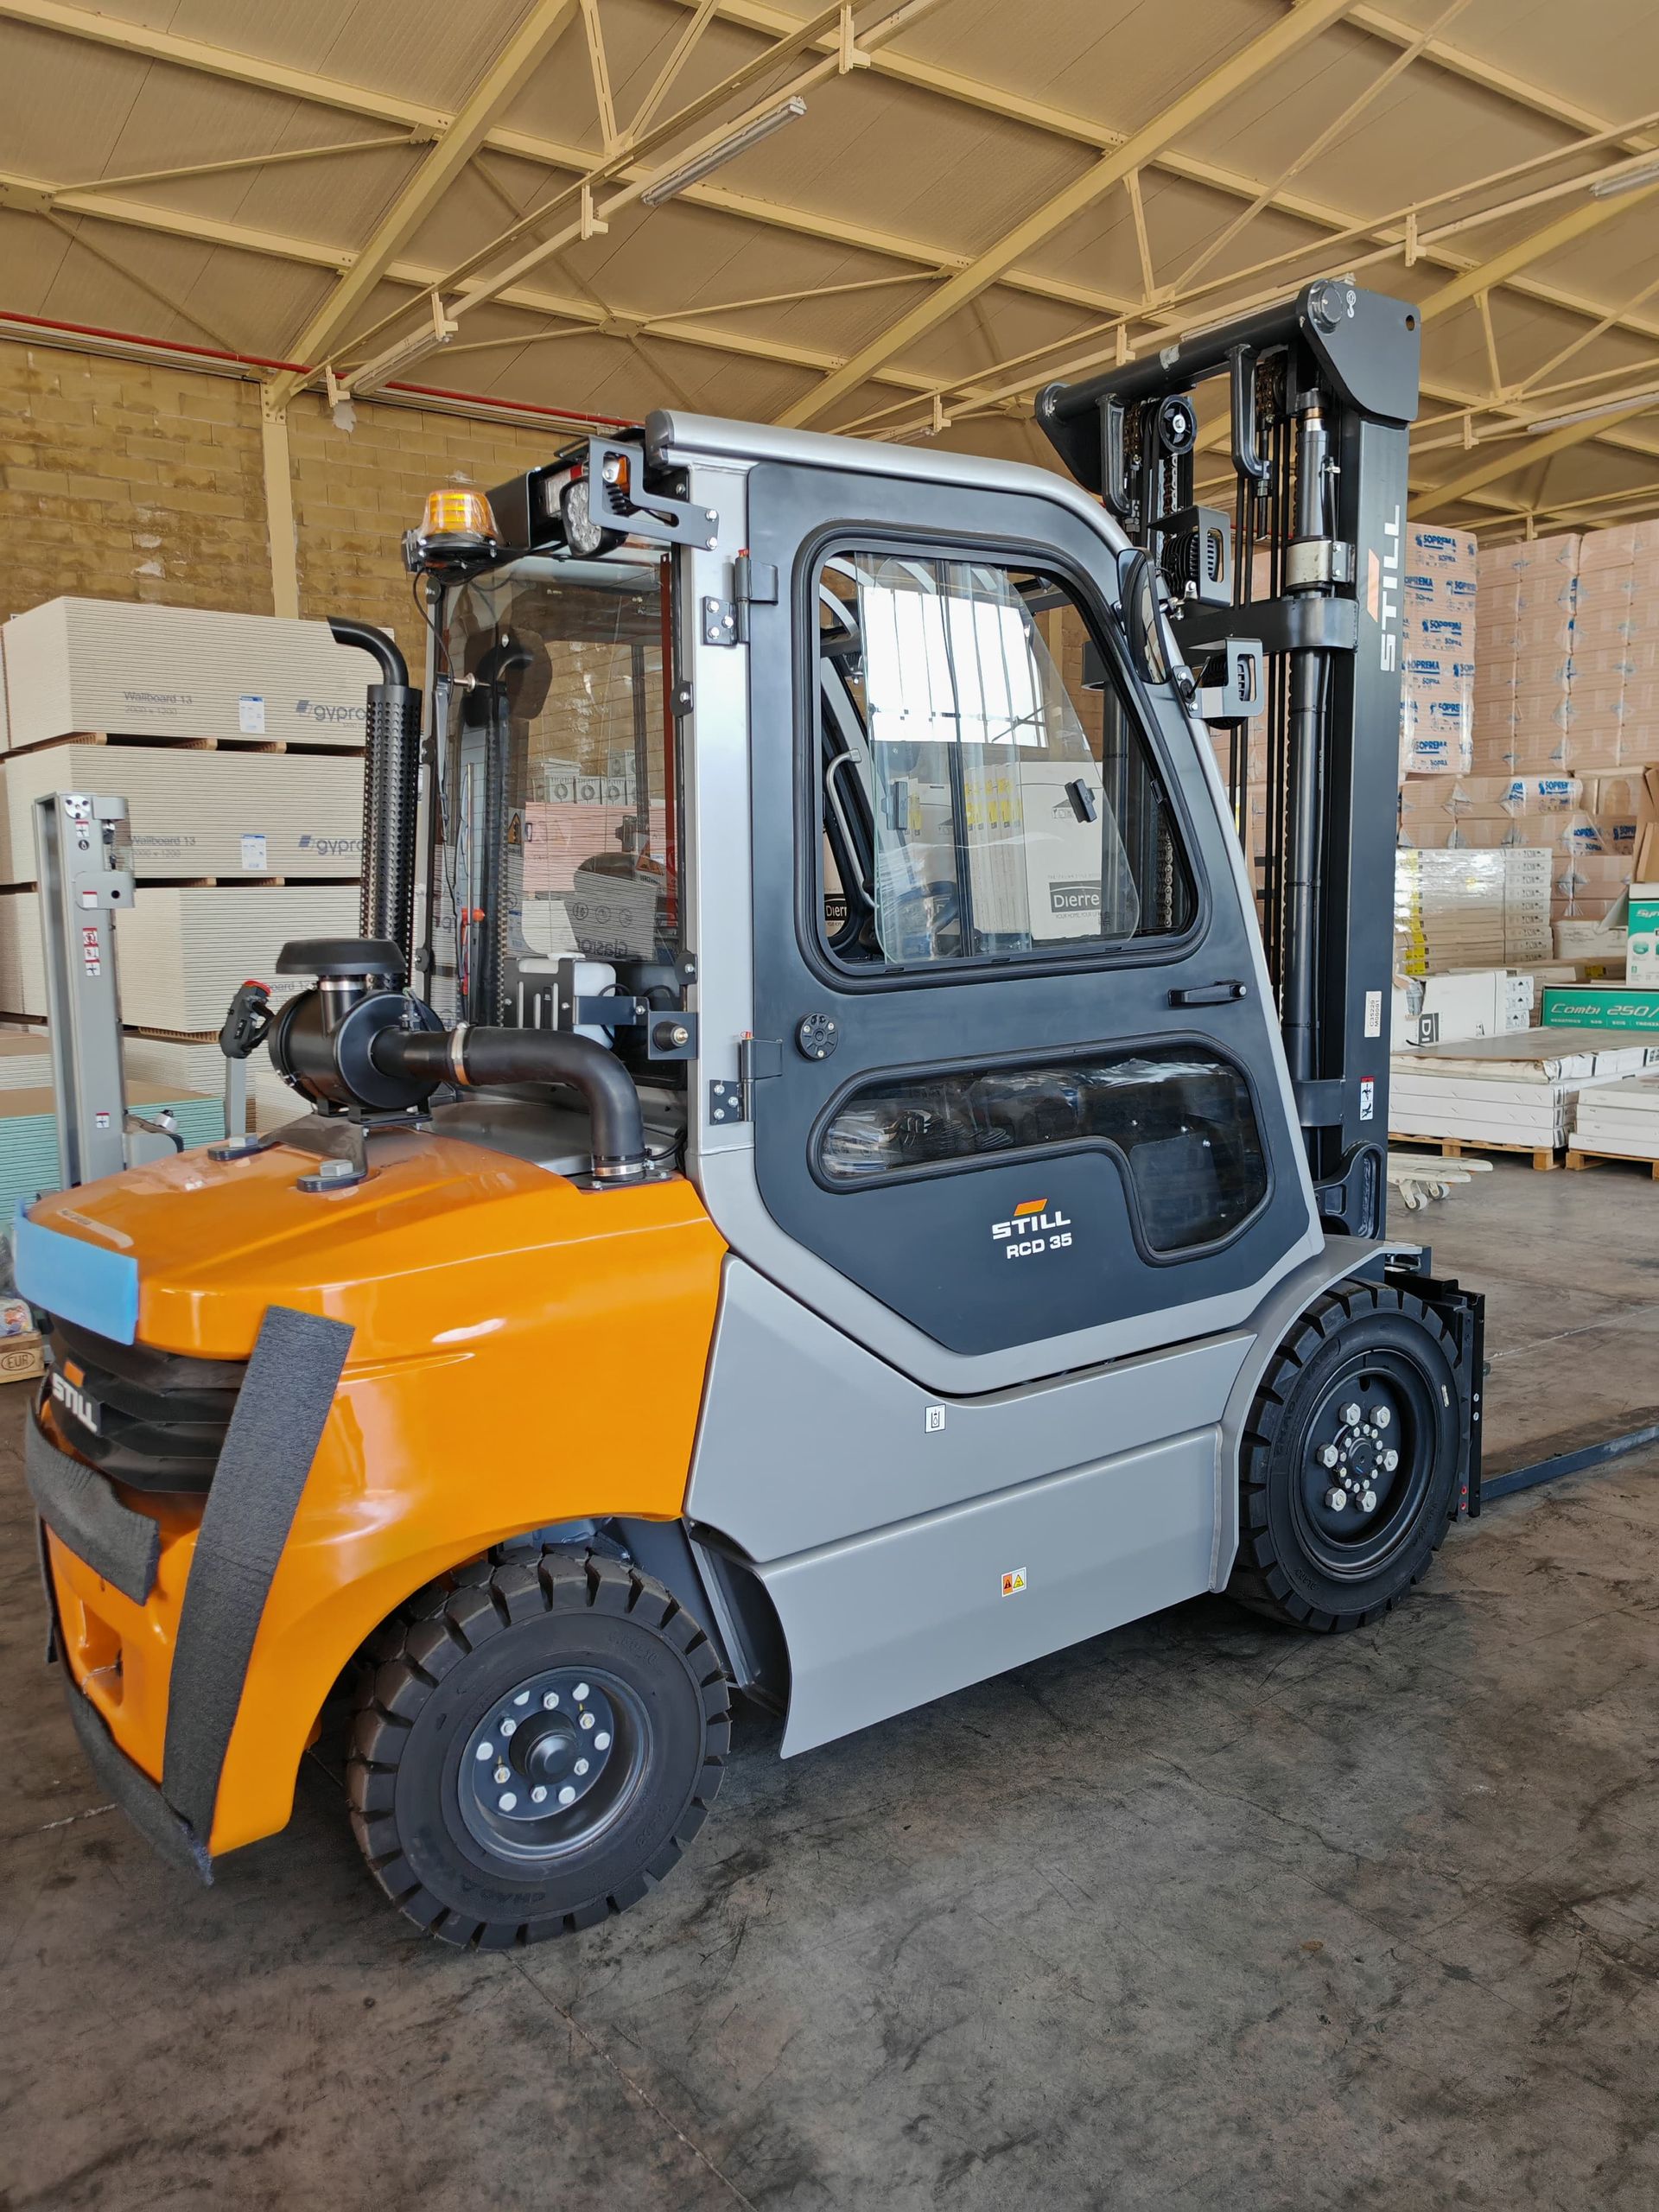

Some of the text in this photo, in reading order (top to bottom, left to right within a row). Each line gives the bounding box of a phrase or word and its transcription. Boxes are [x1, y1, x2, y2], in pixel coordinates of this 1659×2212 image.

[1380, 505, 1400, 672] STILL
[184, 836, 196, 846] 13
[1053, 893, 1100, 908] Dierre
[1551, 1003, 1601, 1014] Combi
[991, 1211, 1071, 1240] STILL
[1006, 1232, 1072, 1260] RCD 35
[7, 1354, 29, 1369] EUR
